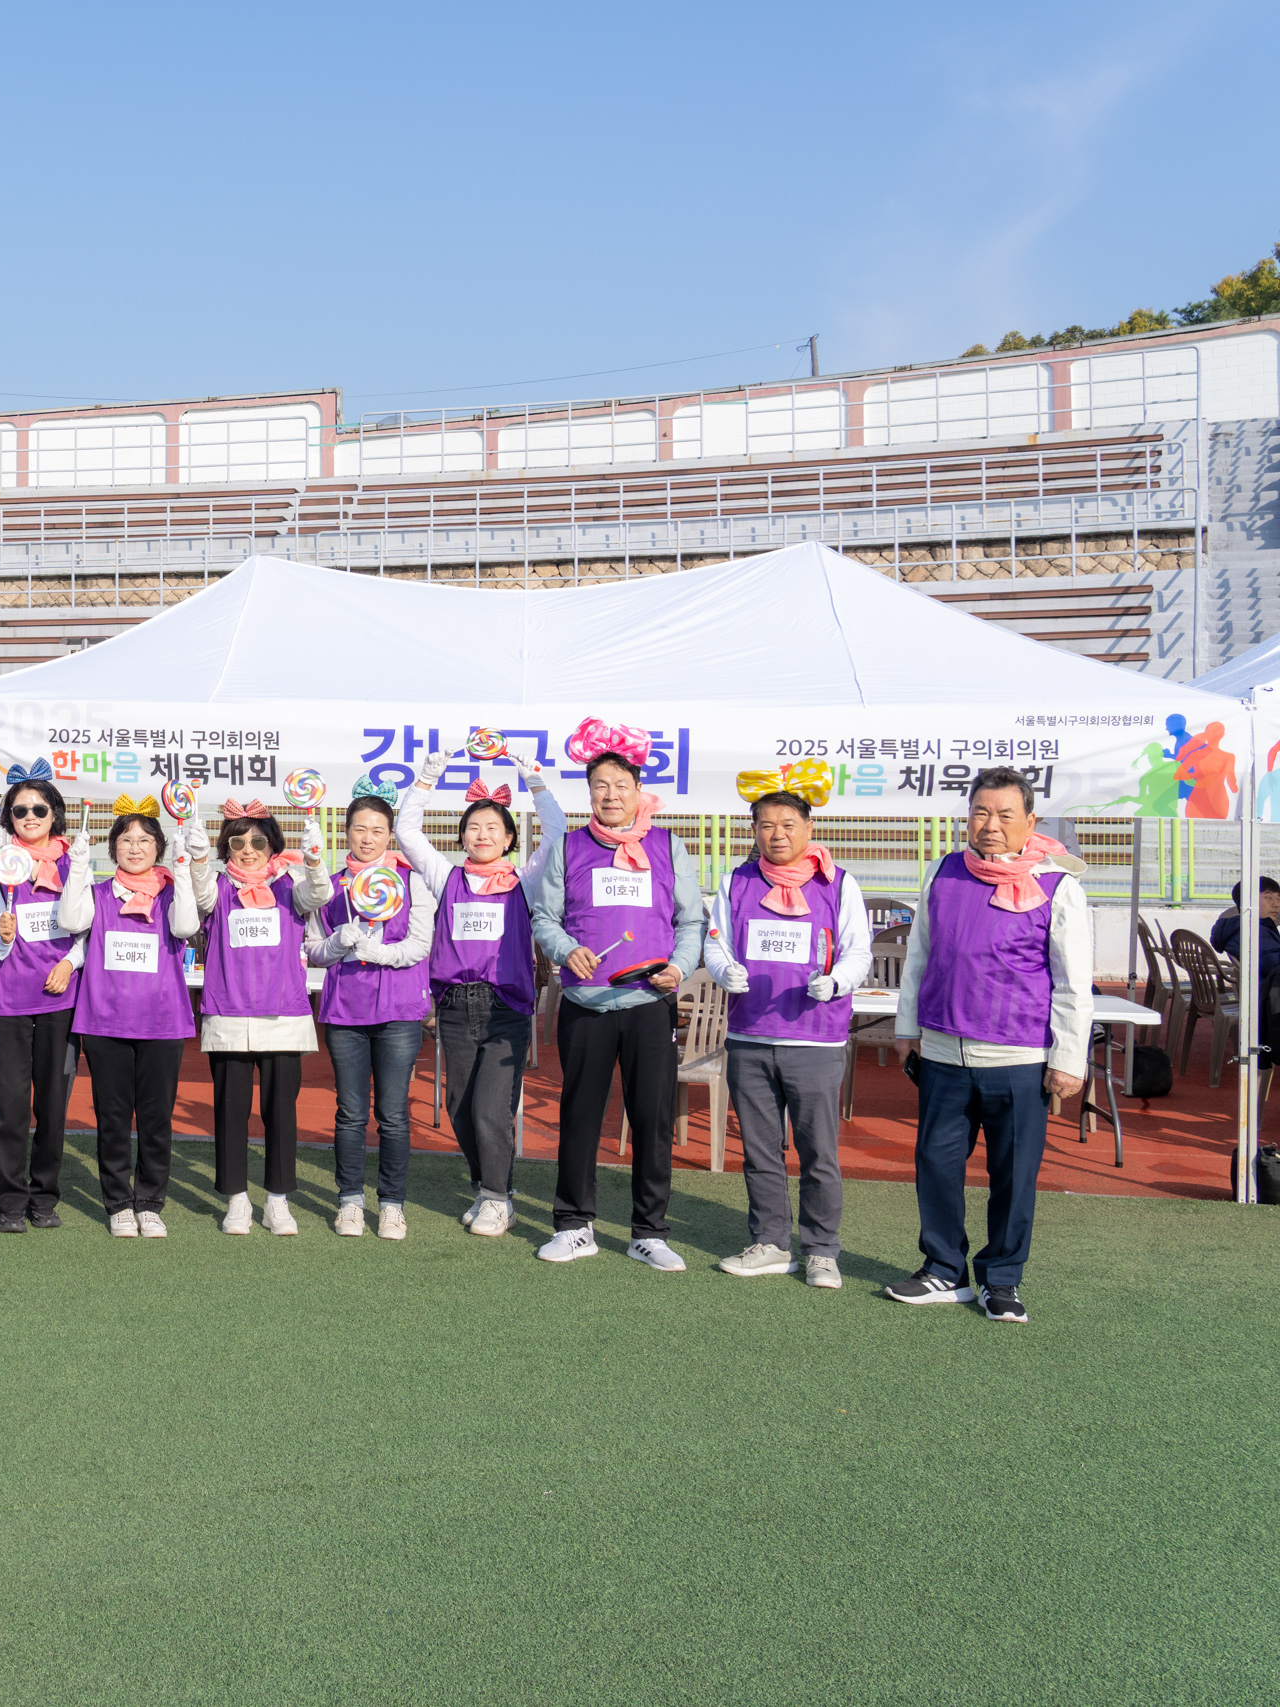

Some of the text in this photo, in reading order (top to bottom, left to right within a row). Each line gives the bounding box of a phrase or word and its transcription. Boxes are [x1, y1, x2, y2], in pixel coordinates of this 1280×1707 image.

[1014, 715, 1155, 727] 서울특별시구의회의장협의회
[48, 728, 280, 750] 2025 서울특별시 구의회의원
[775, 737, 1060, 761] 2025 서울특별시 구의회의원
[51, 750, 278, 787] 한마음 체육대회
[898, 762, 1054, 799] 체육회
[605, 885, 639, 897] 이호귀
[25, 910, 50, 919] 강남구의회
[460, 911, 497, 919] 강남구의회 의원
[238, 926, 270, 938] 이향숙
[463, 920, 493, 932] 손민기
[788, 931, 802, 939] 의원
[112, 940, 140, 949] 강남구의회
[760, 940, 797, 953] 황영각
[115, 951, 147, 964] 노애자
